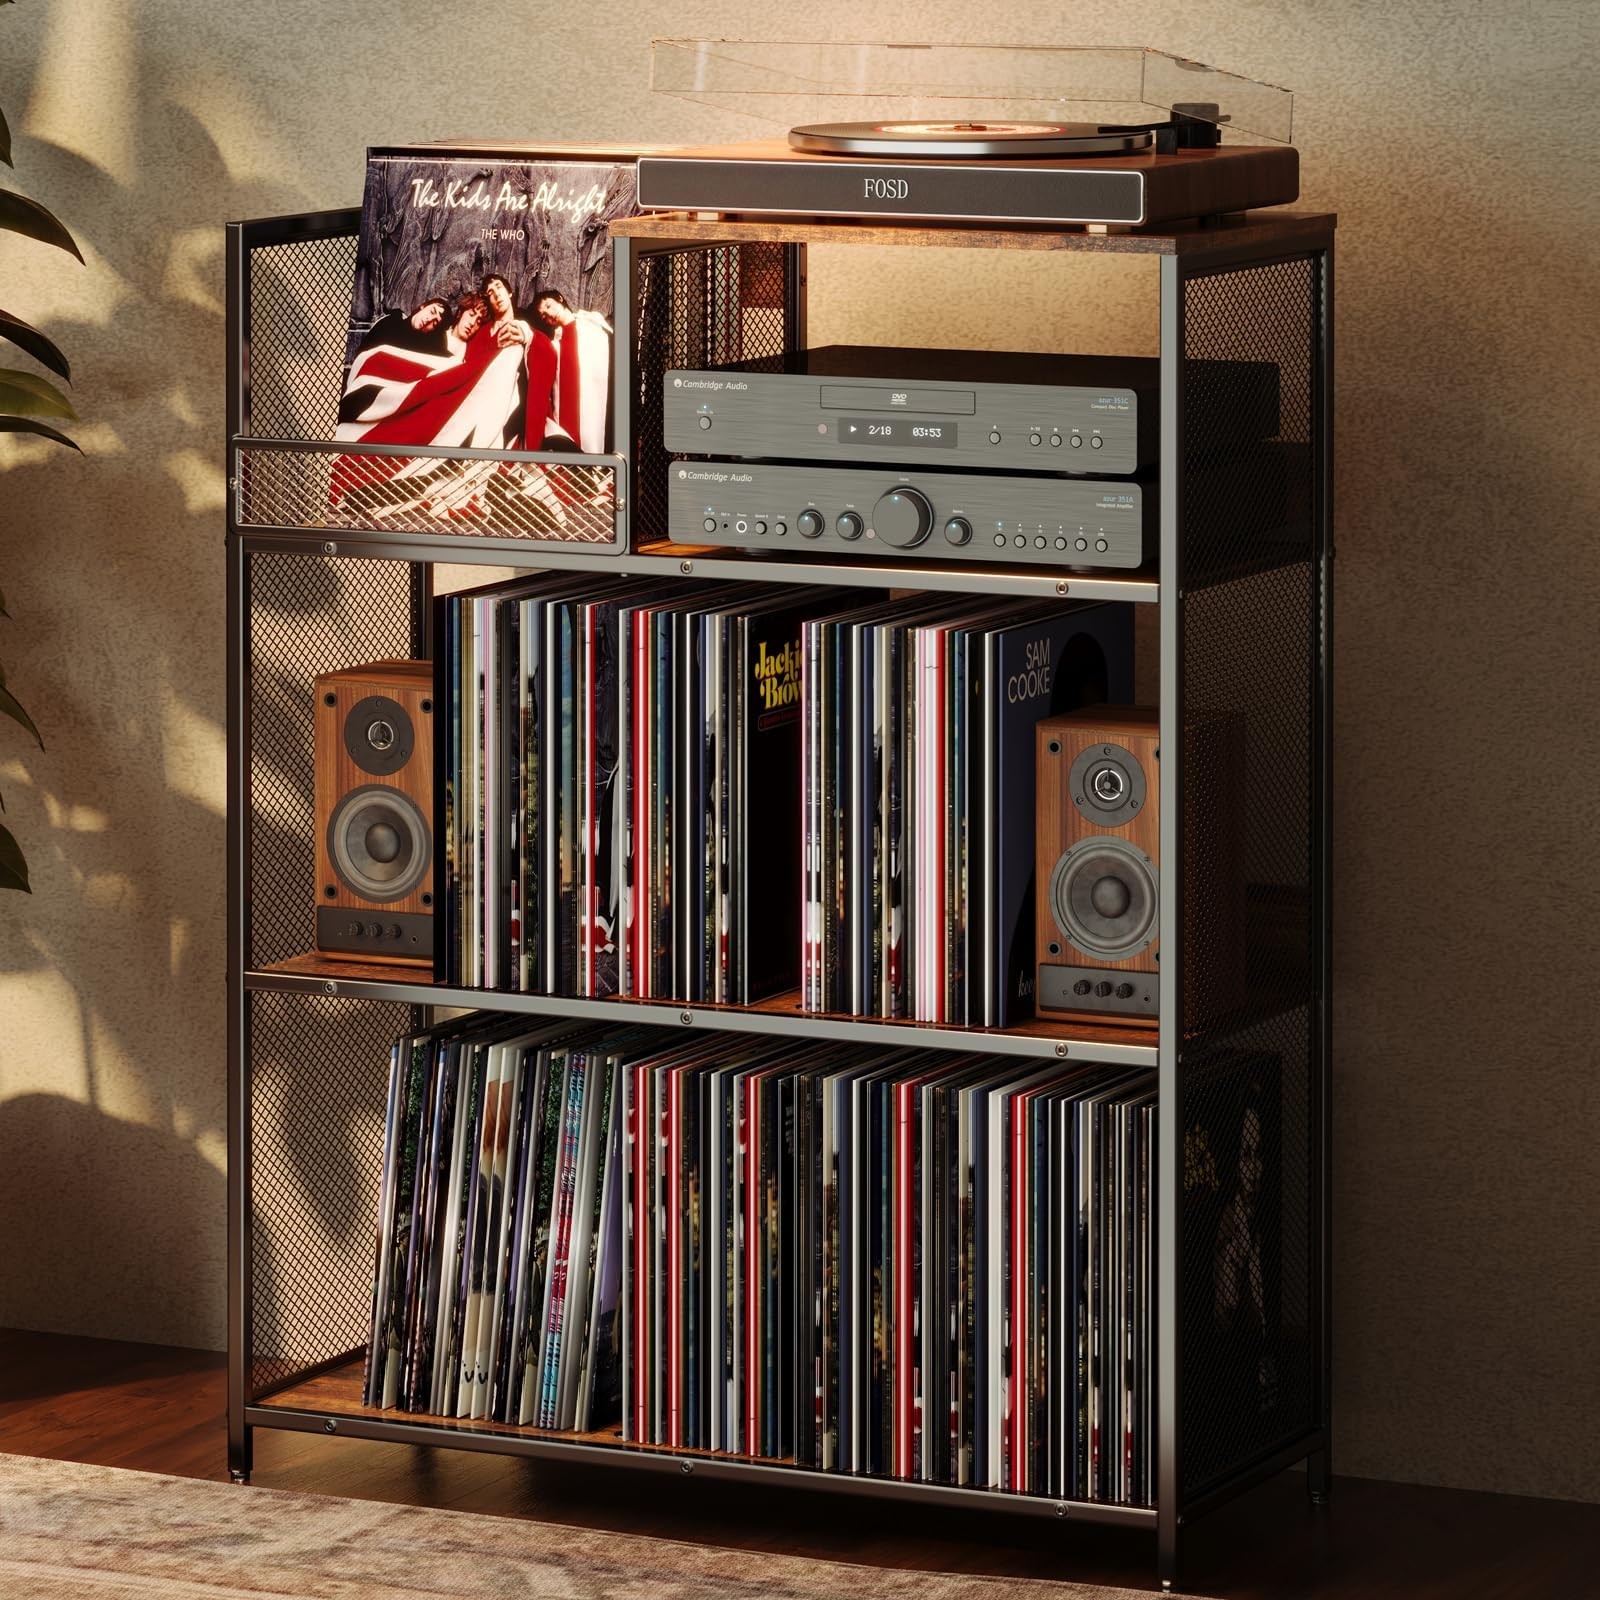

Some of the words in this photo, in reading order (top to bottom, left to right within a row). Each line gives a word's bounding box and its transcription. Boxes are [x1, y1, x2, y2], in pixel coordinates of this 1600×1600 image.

[863, 178, 909, 199] FOSD
[411, 178, 440, 209] The
[443, 180, 492, 211] Kids
[491, 180, 528, 213] Are
[531, 181, 607, 224] Alright
[481, 228, 498, 241] THE
[500, 229, 526, 242] WHO
[683, 379, 724, 391] Cambridge
[726, 380, 748, 391] Audio
[868, 425, 892, 436] 2/18
[912, 427, 942, 438] 03:53
[688, 471, 728, 483] Cambridge
[731, 472, 753, 483] Audio
[755, 639, 803, 680] Jacki
[1025, 637, 1050, 670] SAM
[1007, 666, 1050, 704] COOKE
